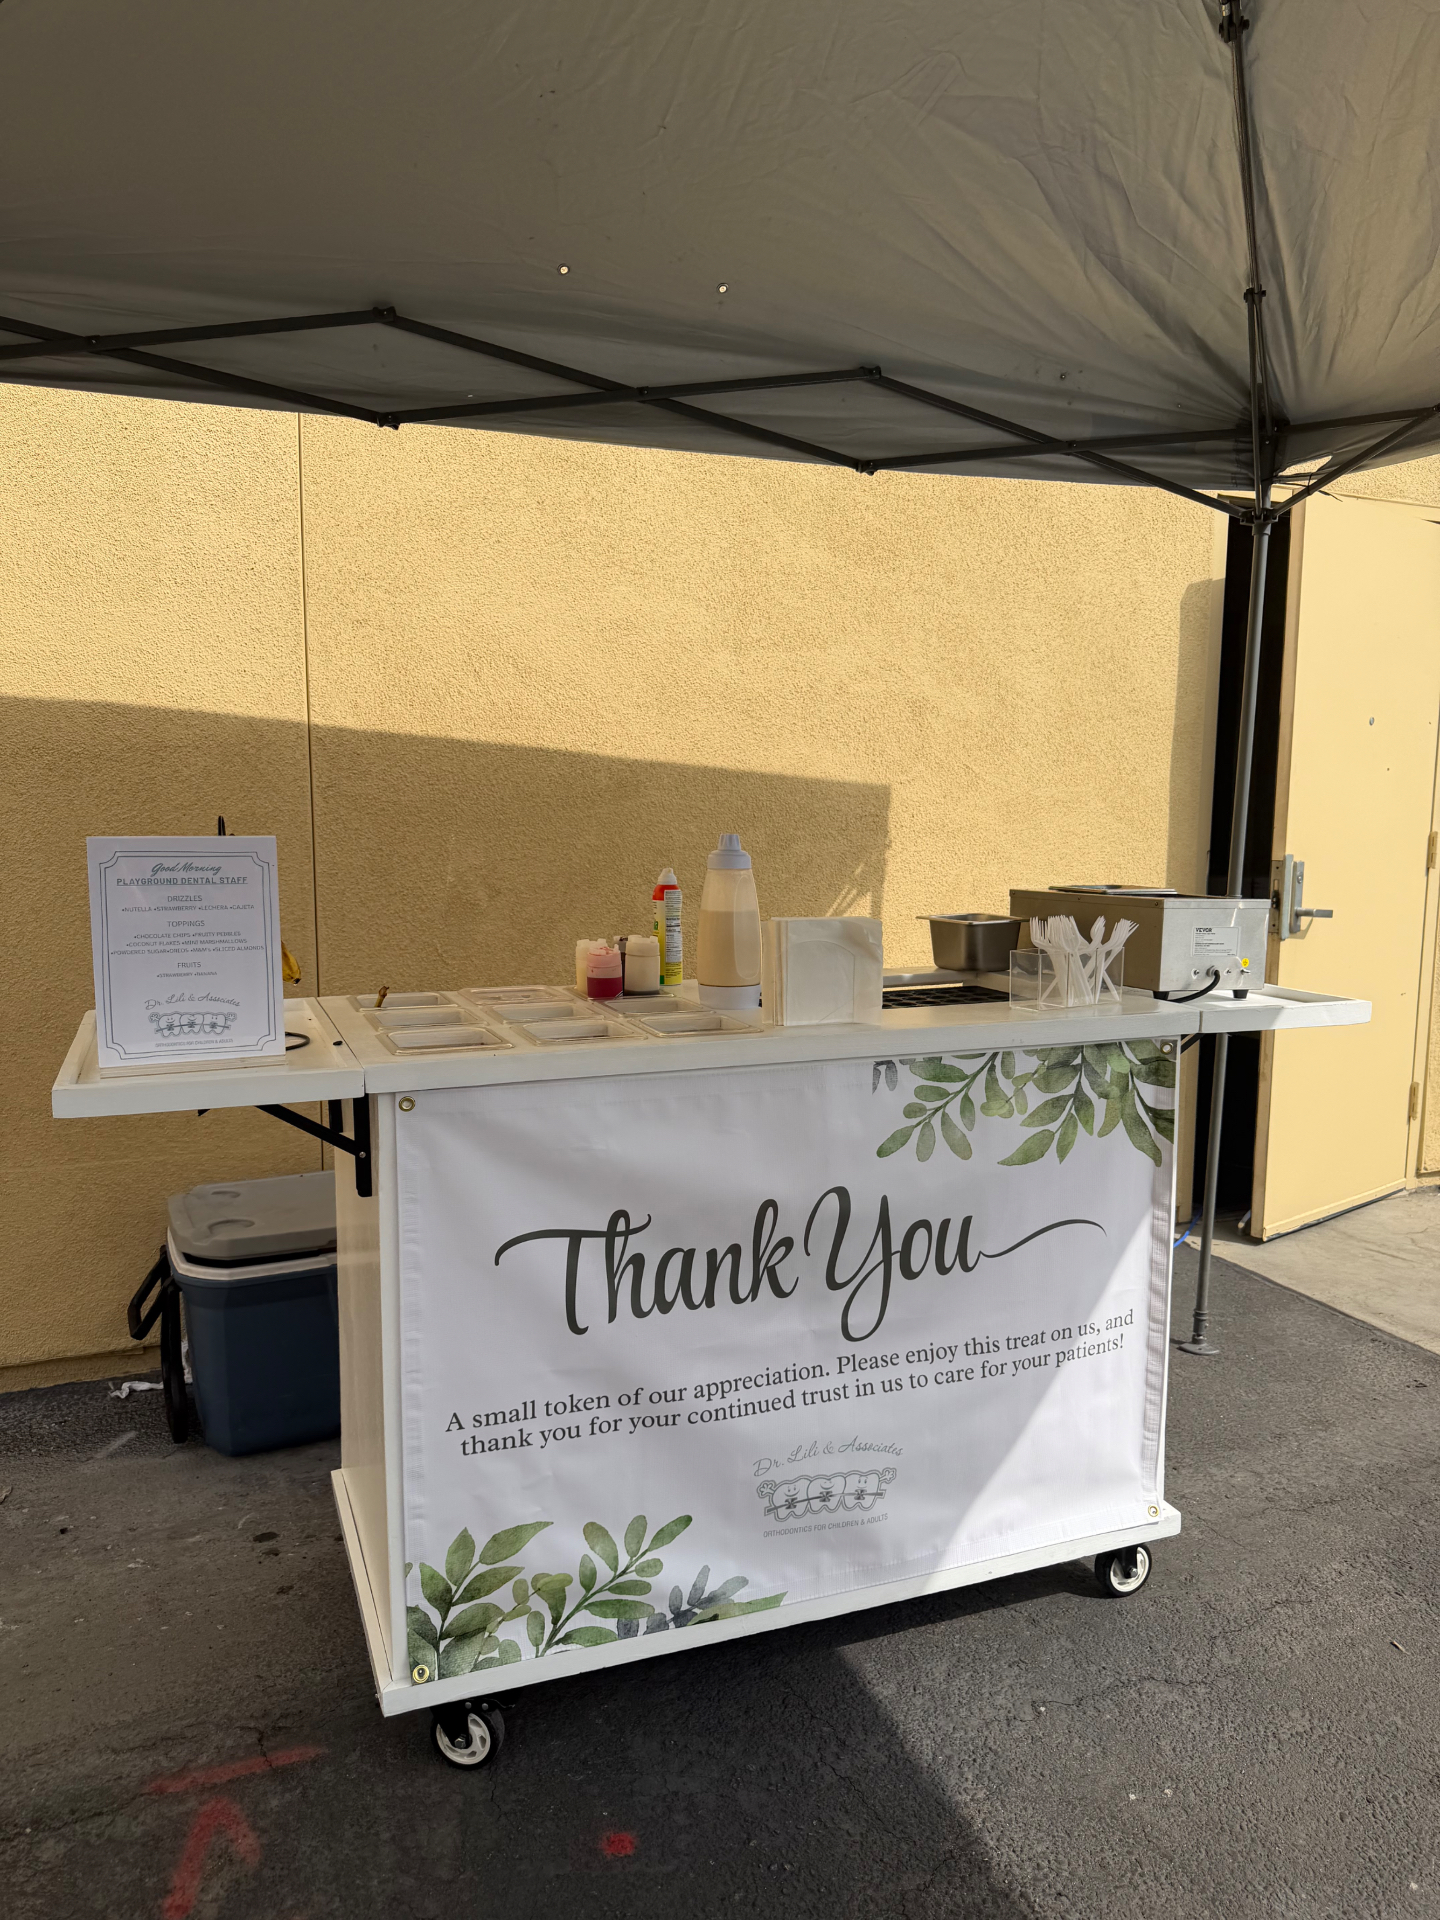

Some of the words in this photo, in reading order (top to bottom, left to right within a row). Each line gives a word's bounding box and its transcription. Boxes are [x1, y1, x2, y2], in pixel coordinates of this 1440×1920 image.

[117, 878, 178, 886] PLAYGROUND
[181, 877, 217, 885] DENTAL
[219, 876, 248, 884] STAFF
[150, 862, 178, 877] Good
[174, 862, 222, 876] Morning
[144, 999, 164, 1010] Dr.
[165, 993, 186, 1004] Lili
[198, 992, 240, 1006] Associates
[495, 1198, 799, 1335] Thank
[804, 1186, 1107, 1342] You
[445, 1412, 465, 1432] A
[472, 1400, 537, 1427] small
[544, 1394, 611, 1418] token
[617, 1387, 643, 1406] of
[648, 1386, 687, 1404] our
[693, 1362, 830, 1402] appreciation.
[836, 1350, 899, 1375] Please
[905, 1342, 958, 1364] enjoy
[963, 1335, 1001, 1357] this
[1005, 1329, 1046, 1351] treat
[1050, 1326, 1072, 1343] on
[1077, 1320, 1101, 1337] us,
[1105, 1309, 1134, 1331] and
[461, 1428, 533, 1456] thank
[540, 1423, 582, 1449] you
[588, 1416, 623, 1437] for
[628, 1412, 681, 1434] your
[687, 1388, 796, 1424] continued
[801, 1383, 850, 1407] trust
[855, 1378, 875, 1398] in
[881, 1375, 903, 1393] us
[909, 1371, 929, 1389] to
[934, 1367, 975, 1385] care
[980, 1359, 1007, 1379] for
[1011, 1354, 1051, 1377] your
[1055, 1333, 1124, 1368] patients!
[753, 1458, 785, 1477] Dr.
[787, 1440, 819, 1463] Lili
[822, 1441, 835, 1454] &
[838, 1435, 904, 1456] Associates
[763, 1525, 812, 1538] ORTHODONTICS
[814, 1523, 826, 1531] FOR
[828, 1519, 859, 1530] CHILDREN
[867, 1513, 888, 1524] ADULTS
